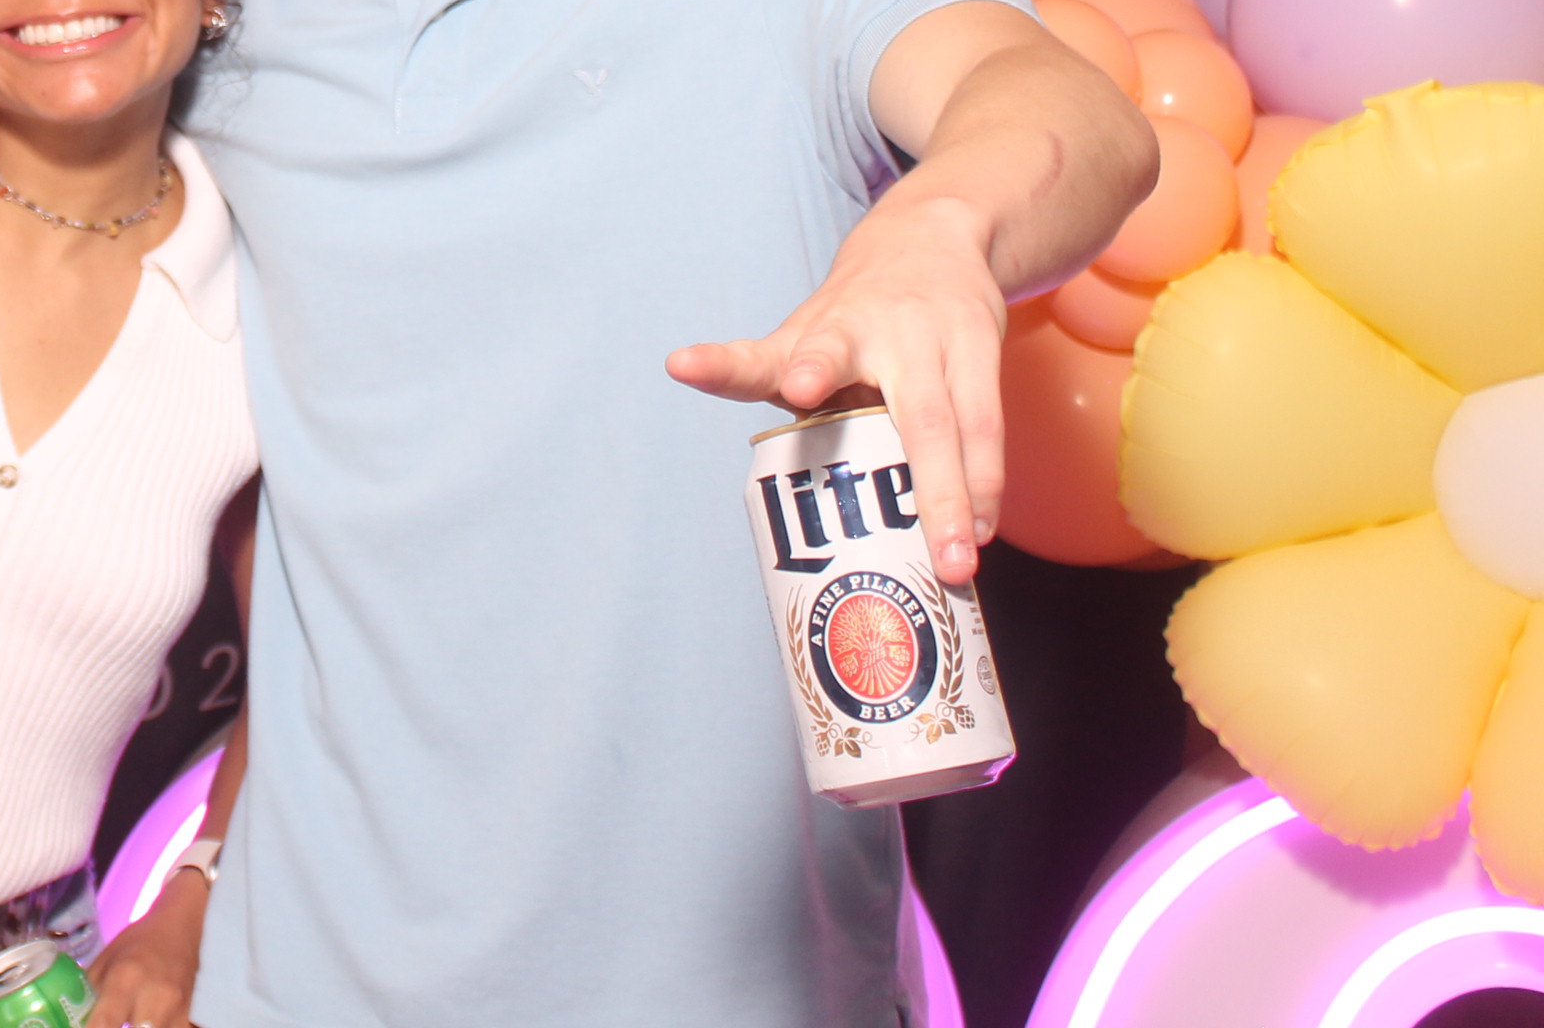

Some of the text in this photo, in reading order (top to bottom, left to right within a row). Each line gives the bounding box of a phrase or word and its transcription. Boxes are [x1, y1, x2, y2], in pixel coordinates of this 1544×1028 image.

[756, 460, 919, 574] Lite
[811, 581, 845, 627] FINE
[848, 573, 926, 628] PILSNER
[810, 632, 823, 647] A
[858, 695, 916, 721] BEER
